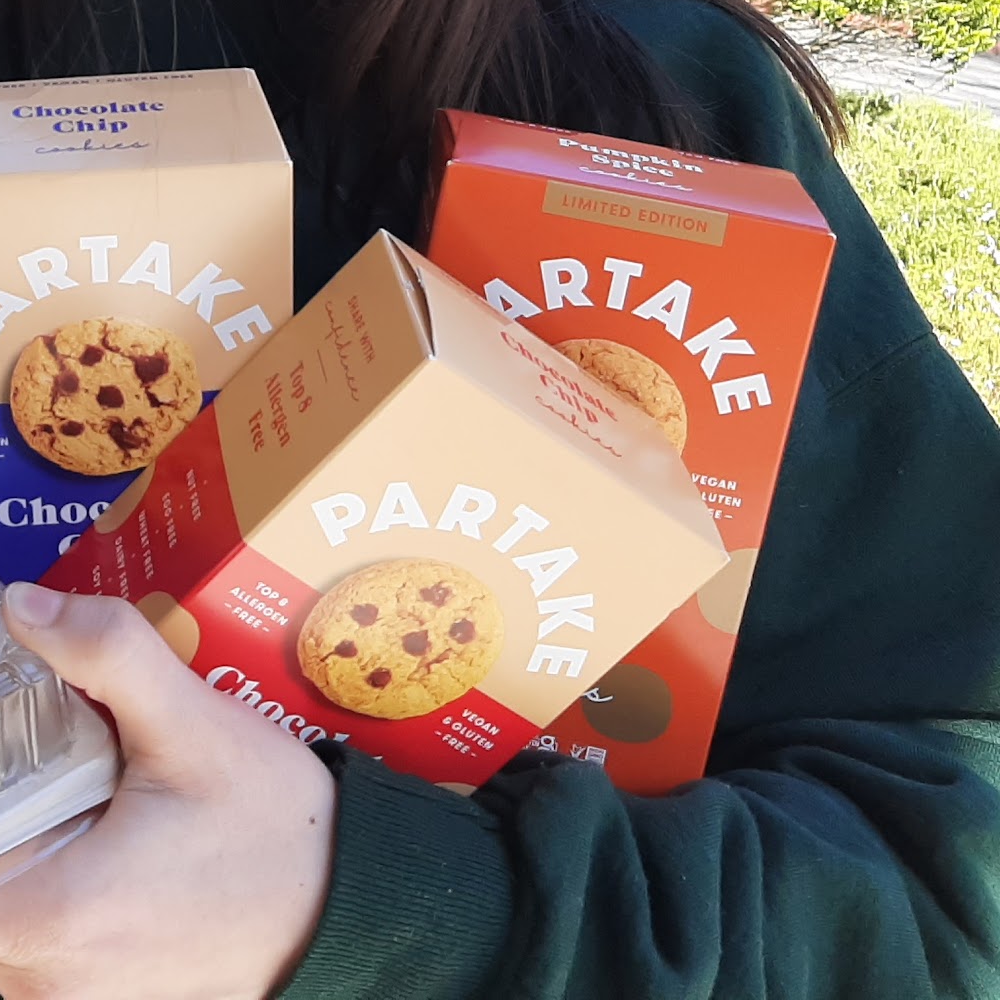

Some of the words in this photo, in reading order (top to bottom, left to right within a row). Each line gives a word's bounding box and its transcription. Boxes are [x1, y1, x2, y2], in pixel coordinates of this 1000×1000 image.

[12, 101, 165, 118] Chocolate
[53, 119, 129, 133] Chip
[35, 138, 150, 155] cookies
[558, 137, 705, 174] Pumpkin
[591, 153, 675, 178] Spice
[561, 193, 632, 219] LIMITED
[637, 208, 709, 233] EDITION
[359, 332, 377, 364] WITH
[482, 256, 773, 416] ARTAKE
[289, 359, 307, 397] Top
[265, 372, 291, 449] Allergen
[297, 396, 313, 414] 8
[246, 407, 266, 453] Free
[691, 472, 737, 491] VEGAN
[189, 491, 202, 522] FREE
[701, 491, 742, 508] LUTEN
[166, 518, 178, 549] FREE
[143, 549, 154, 581] FREE
[311, 481, 595, 679] PARTAKE
[228, 586, 290, 627] ALLERGEN
[255, 580, 280, 600] TOP
[278, 597, 290, 608] 8
[231, 606, 264, 629] FREE
[205, 665, 351, 747] Choco
[461, 708, 501, 737] VEGAN
[441, 733, 471, 755] FREE
